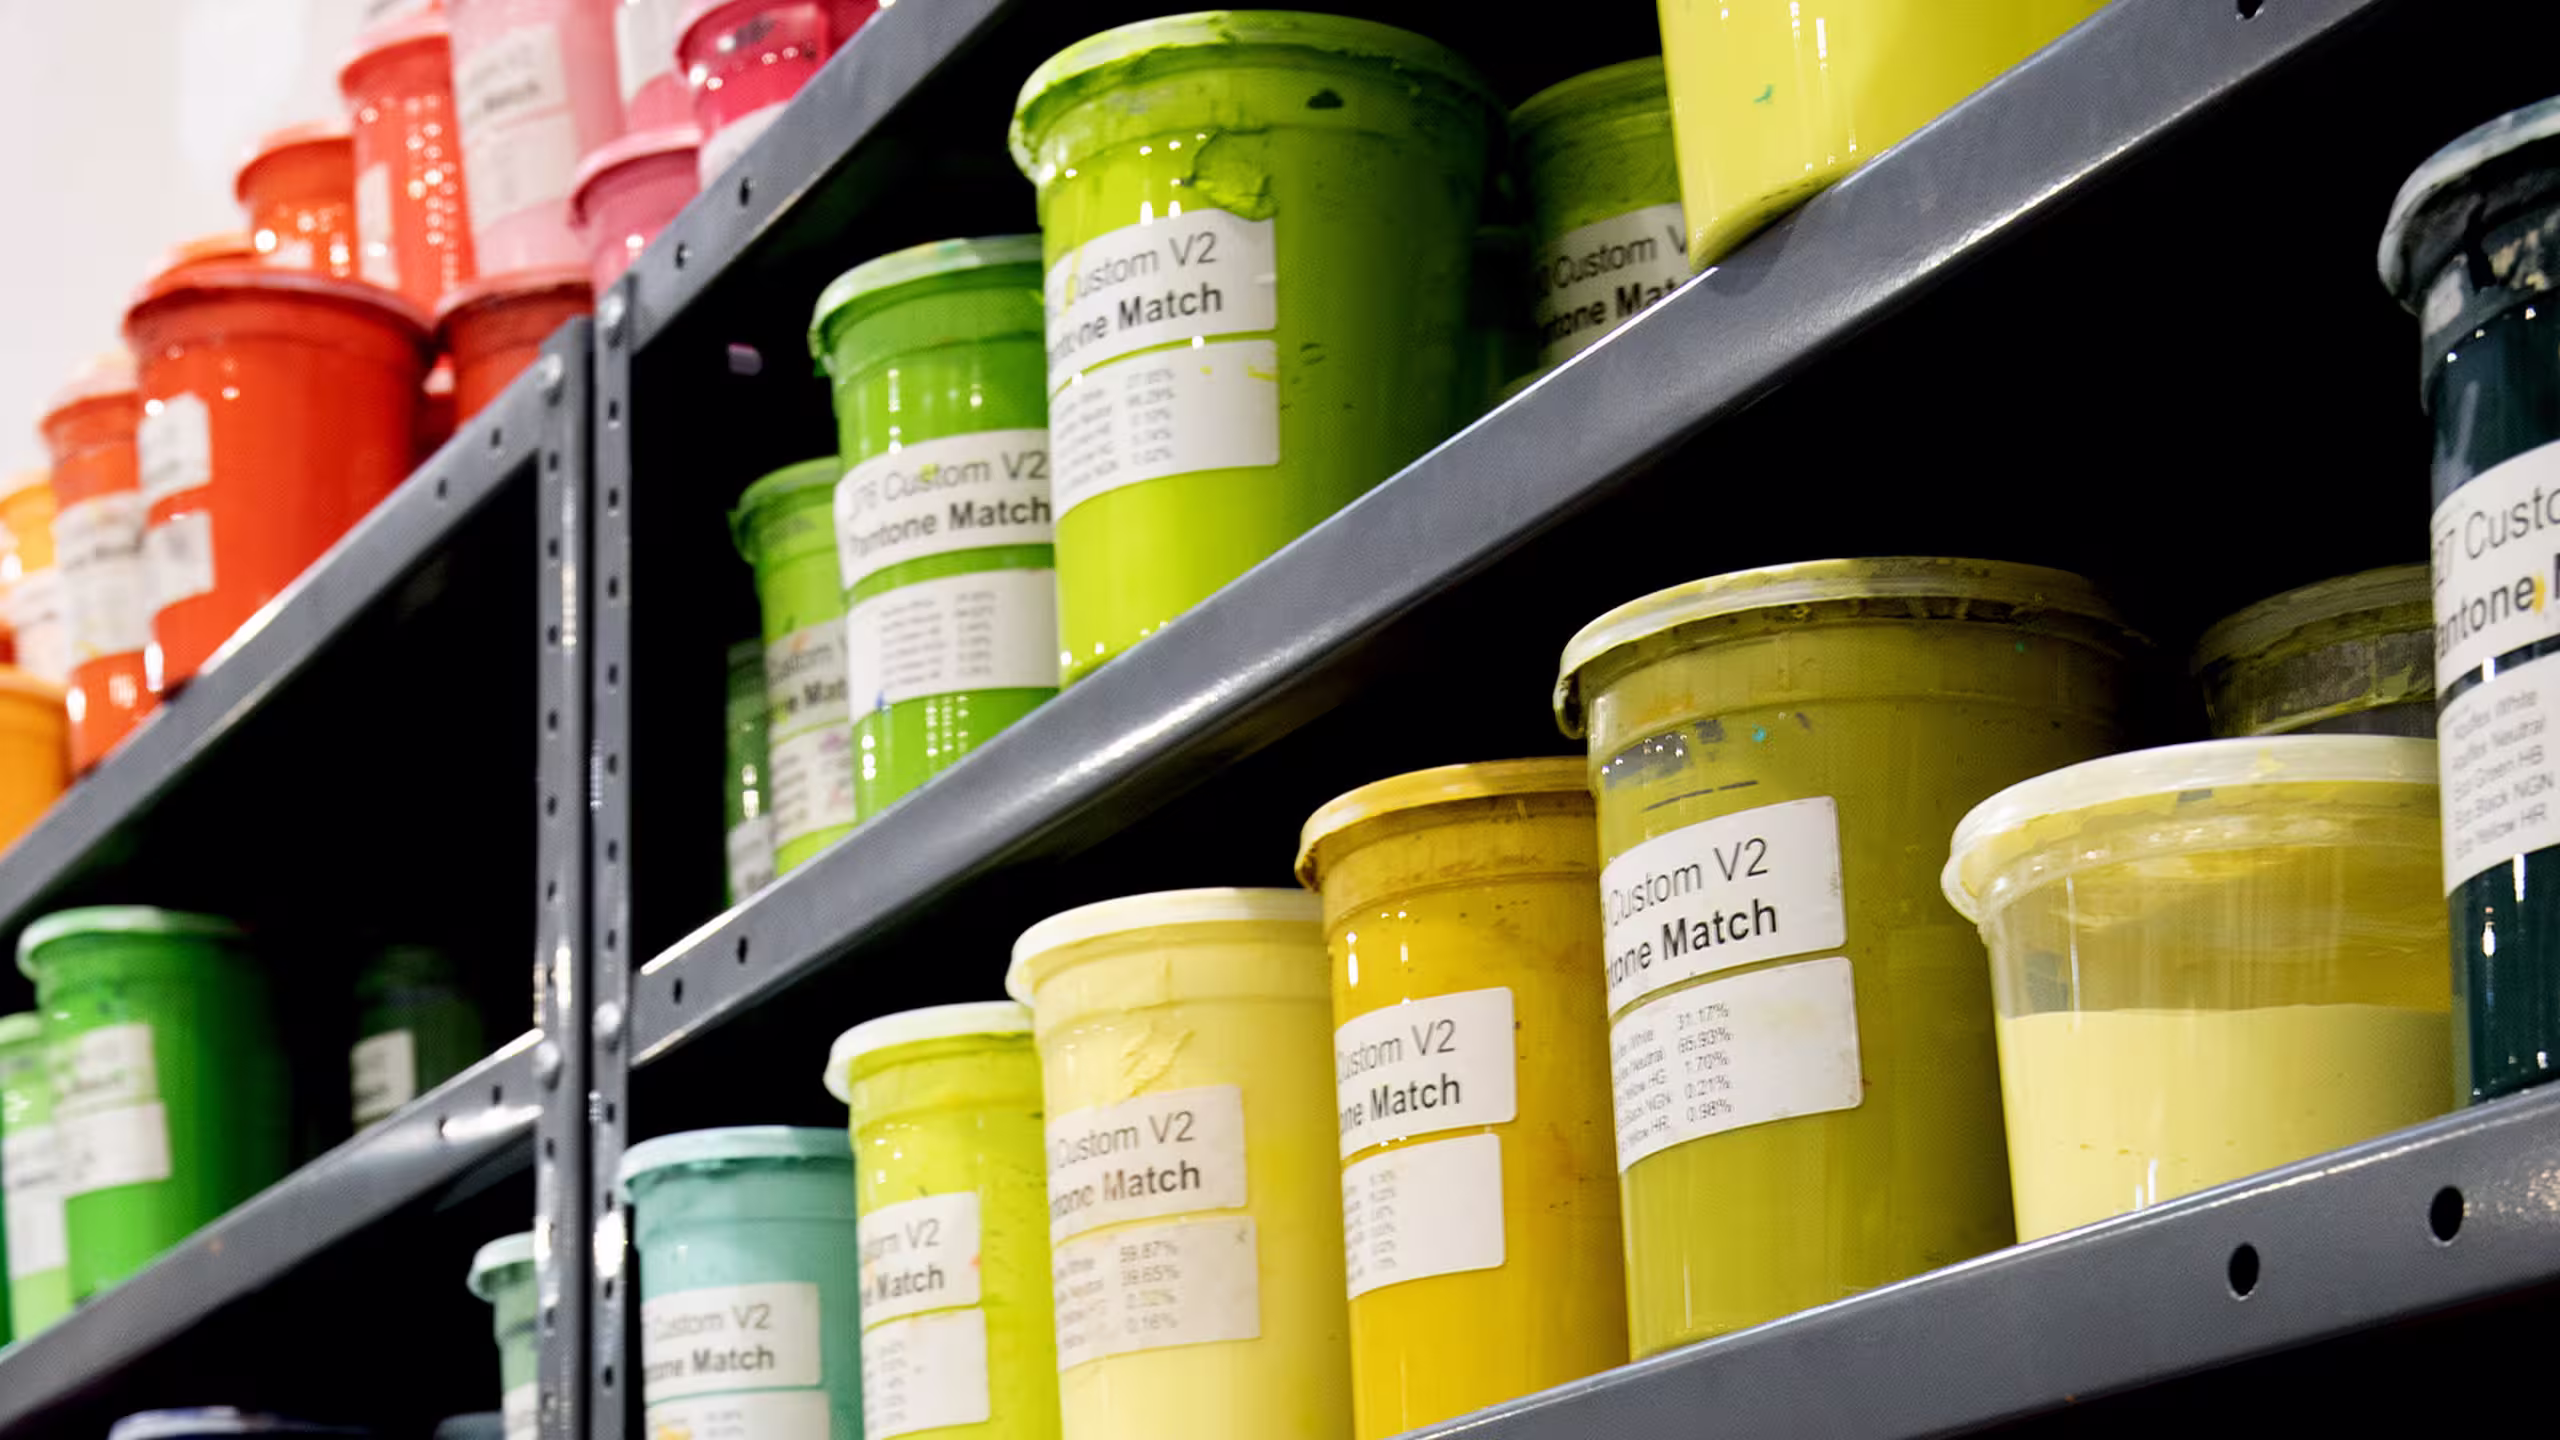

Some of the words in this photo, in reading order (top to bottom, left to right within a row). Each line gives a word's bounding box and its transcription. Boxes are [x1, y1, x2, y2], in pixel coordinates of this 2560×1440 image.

[1168, 231, 1217, 266] V2
[1553, 238, 1656, 288] Custom
[1118, 281, 1223, 331] Match
[1539, 301, 1606, 350] tone
[884, 460, 991, 502] Custom
[1001, 450, 1048, 483] V2
[949, 495, 1051, 531] Match
[1608, 862, 1703, 927] Custom
[1713, 836, 1768, 882] V2
[1661, 898, 1777, 961] Match
[1410, 1018, 1456, 1056] V2
[1370, 1073, 1460, 1122] Match
[1057, 1125, 1139, 1168] Custom
[1149, 1110, 1196, 1145] V2
[1102, 1159, 1200, 1201] Match
[904, 1216, 941, 1249] V2
[877, 1264, 945, 1299] Match
[731, 1302, 771, 1331] V2
[692, 1344, 775, 1374] Match
